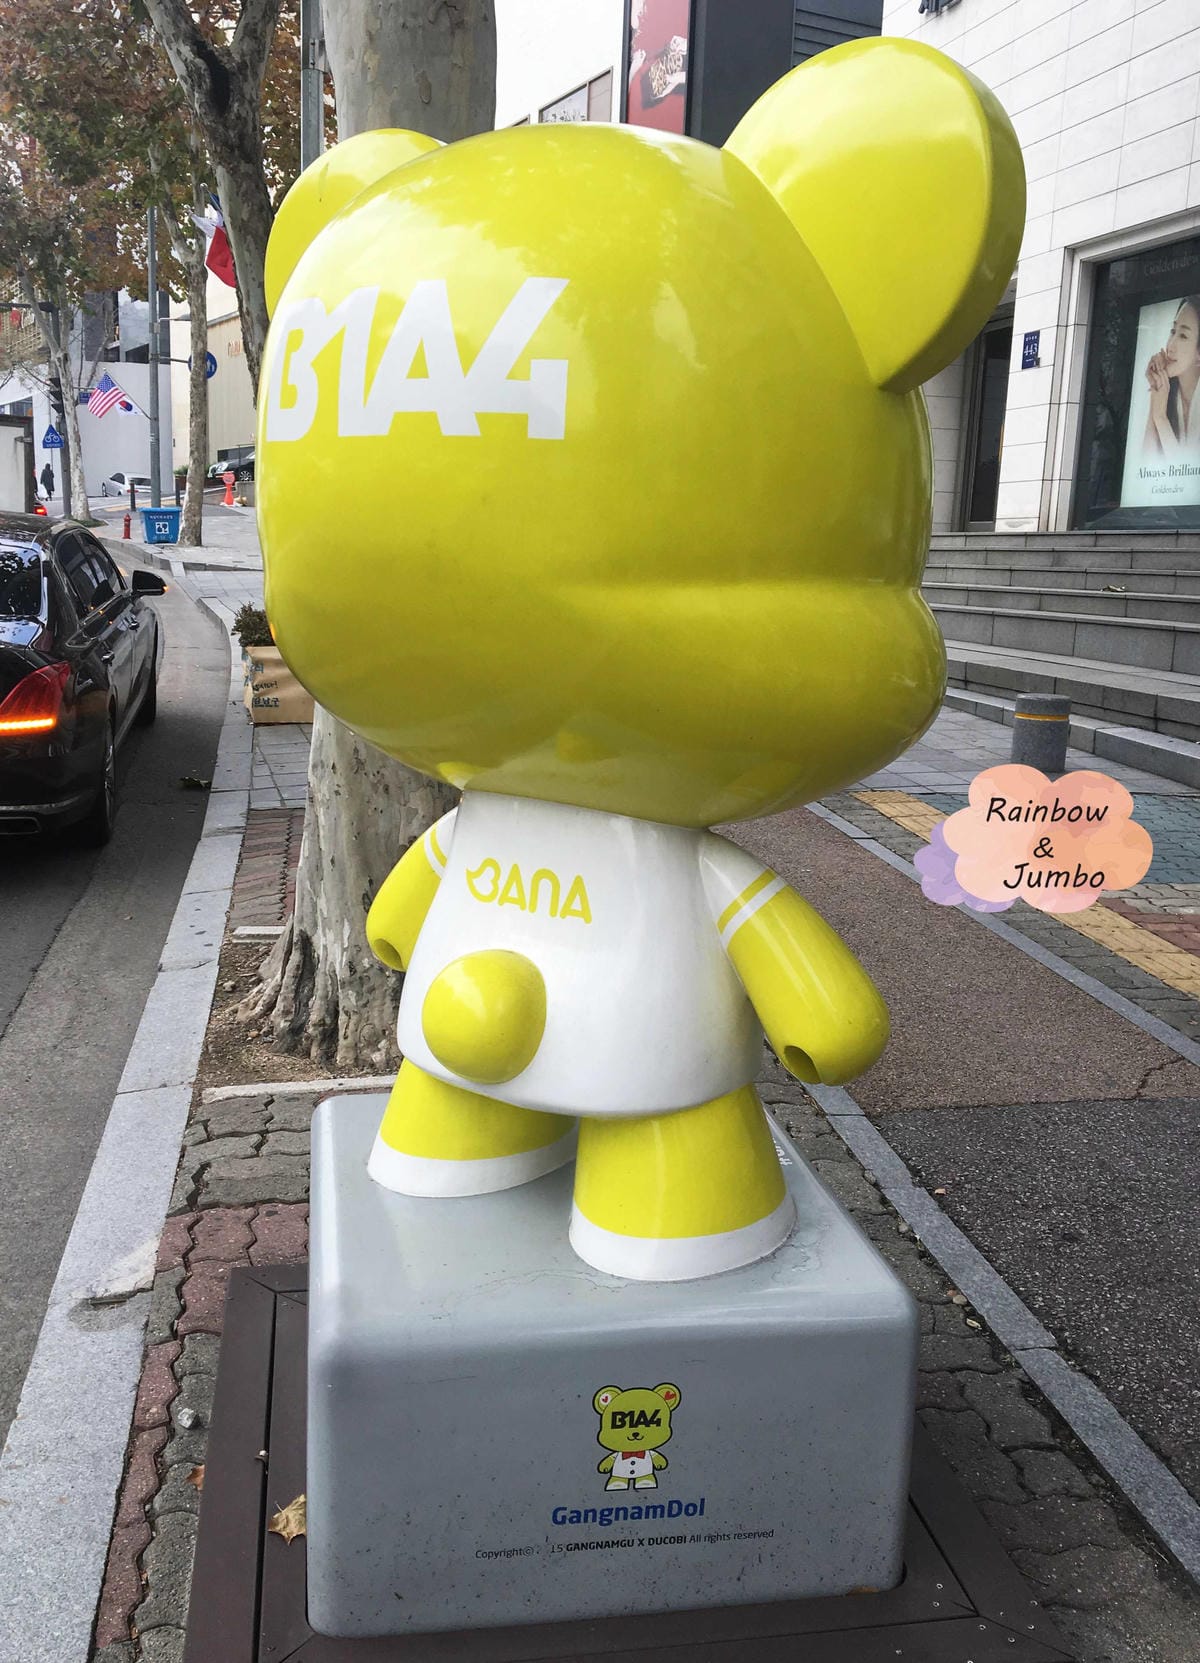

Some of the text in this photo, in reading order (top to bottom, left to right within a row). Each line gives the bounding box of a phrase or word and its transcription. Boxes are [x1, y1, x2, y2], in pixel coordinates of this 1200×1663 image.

[266, 277, 569, 442] B1A4
[1137, 466, 1166, 481] Always
[611, 1409, 662, 1430] B1A4
[552, 1497, 705, 1526] GangnamDol
[566, 1538, 635, 1552] GANGNAMGU
[638, 1537, 645, 1547] X
[648, 1535, 687, 1546] DUCOBI
[689, 1533, 701, 1543] All
[704, 1531, 731, 1543] rights
[733, 1529, 774, 1541] reserved
